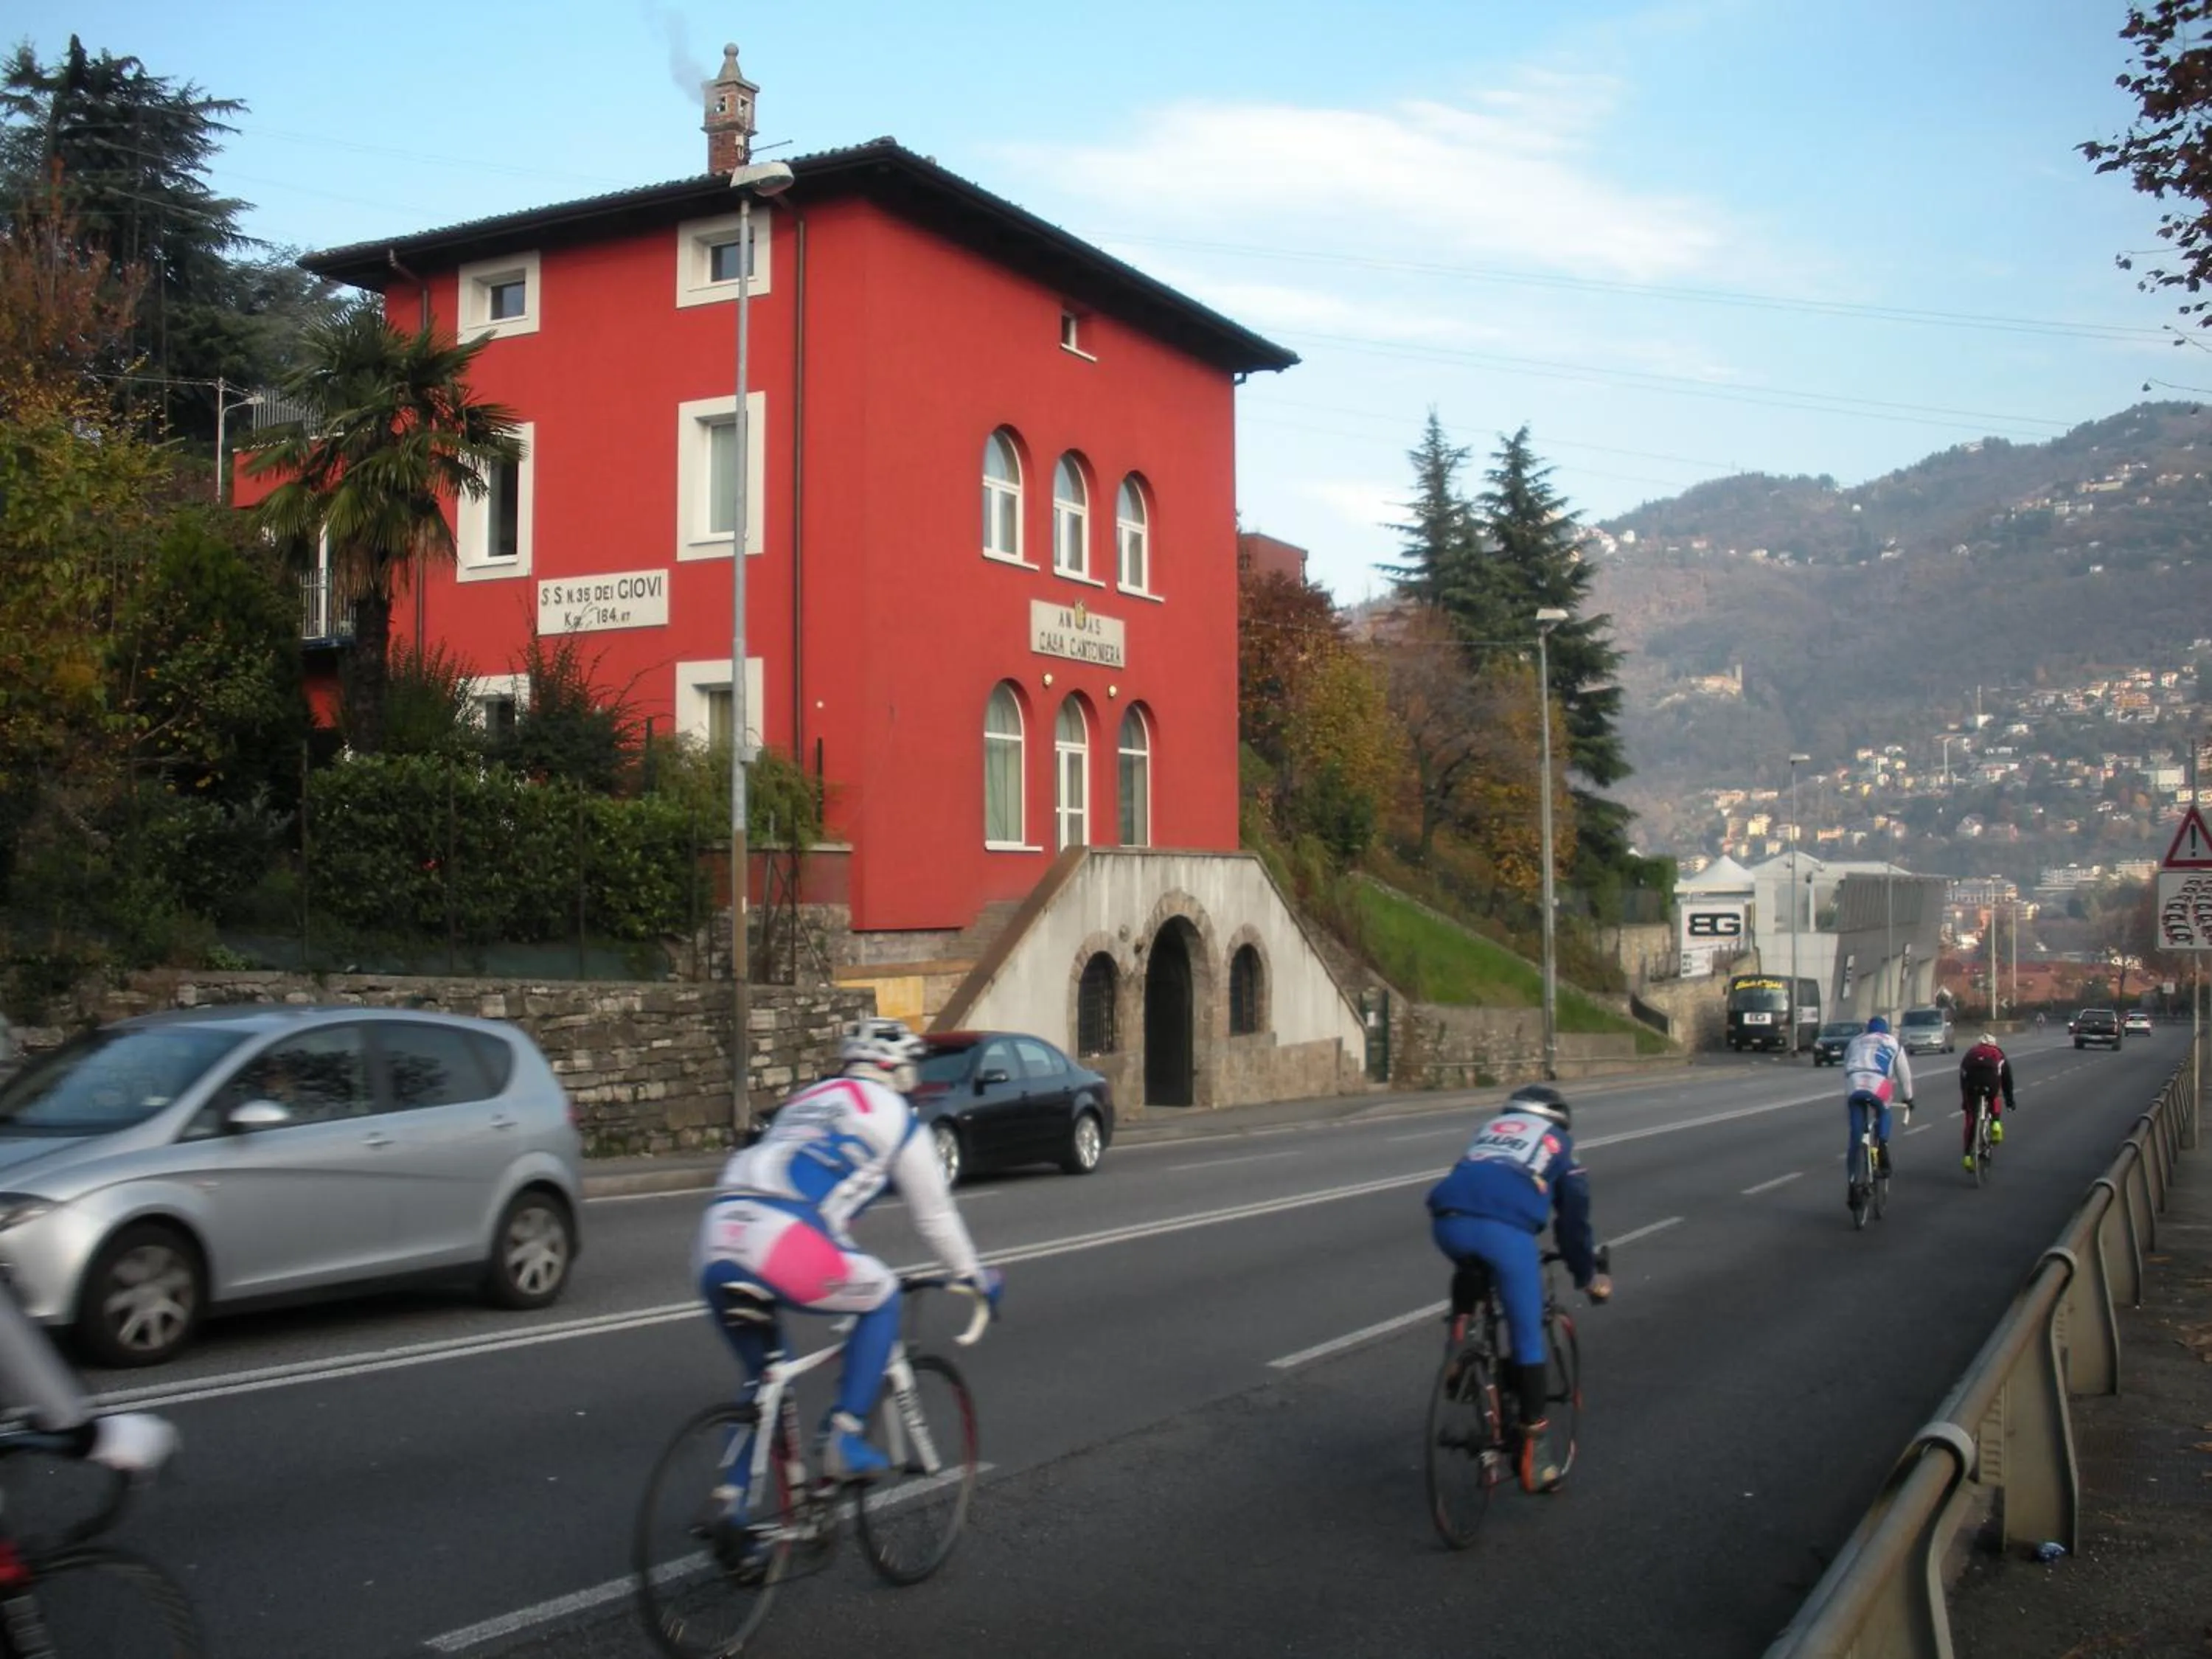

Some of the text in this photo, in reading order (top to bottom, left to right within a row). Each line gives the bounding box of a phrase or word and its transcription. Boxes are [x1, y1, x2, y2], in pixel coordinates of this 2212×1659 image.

[594, 585, 613, 601] DEI
[617, 575, 662, 599] GIOVI
[1039, 630, 1065, 654] CASA
